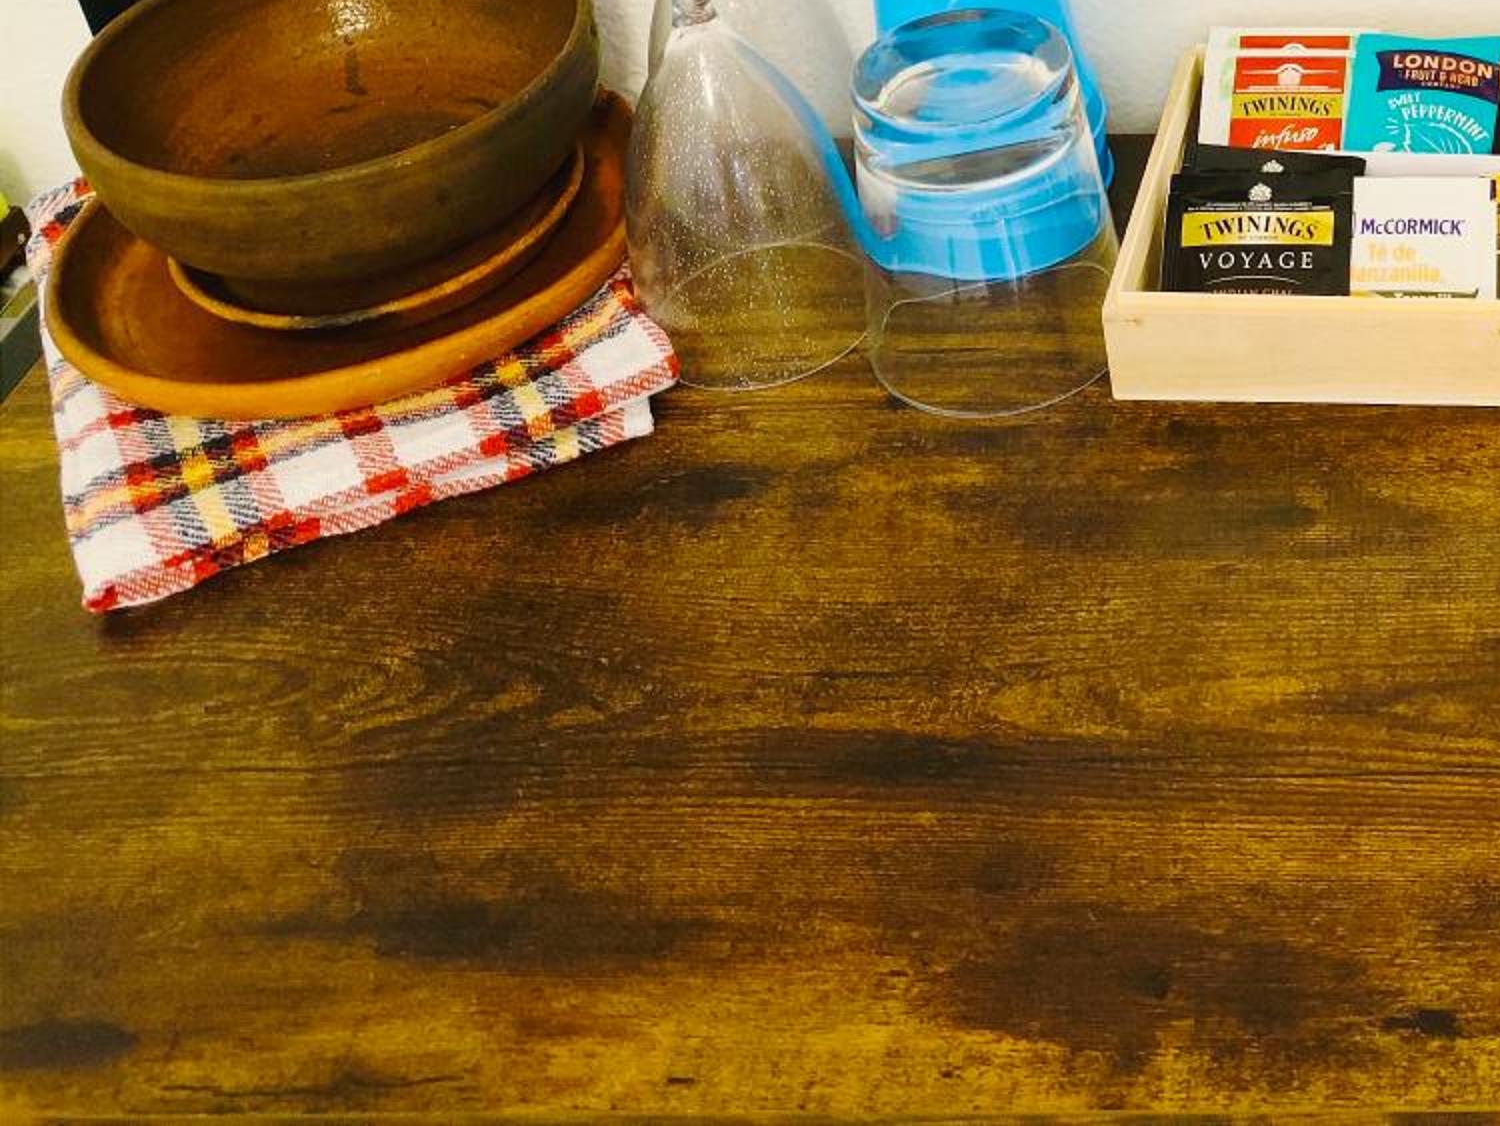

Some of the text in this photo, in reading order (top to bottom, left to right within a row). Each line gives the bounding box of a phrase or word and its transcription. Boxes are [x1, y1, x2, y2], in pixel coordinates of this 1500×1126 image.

[1394, 54, 1493, 79] LONDON
[1240, 94, 1332, 116] TWININGS
[1401, 103, 1490, 141] PEPPERMINT
[1200, 215, 1318, 241] TWININGS
[1360, 217, 1463, 236] McCORMICK
[1199, 251, 1314, 270] VOYAGE
